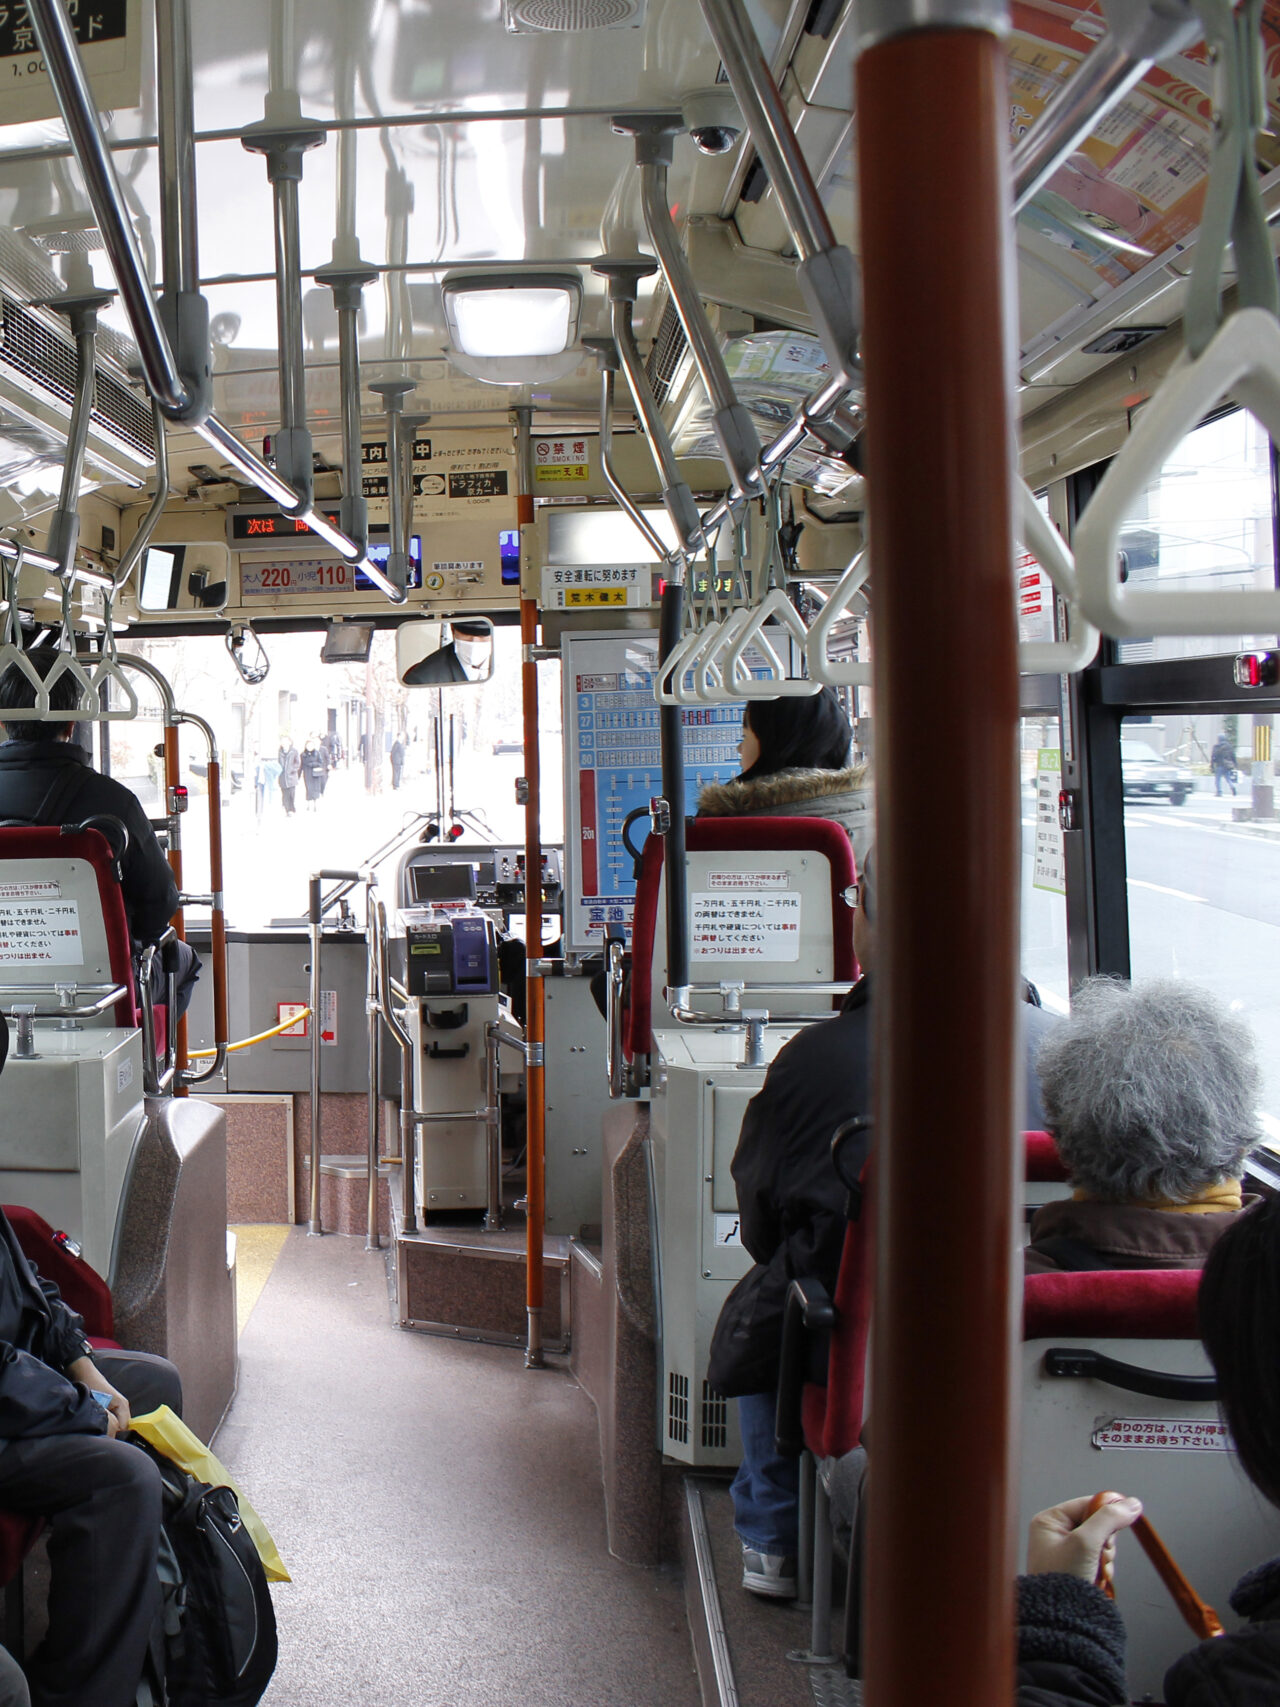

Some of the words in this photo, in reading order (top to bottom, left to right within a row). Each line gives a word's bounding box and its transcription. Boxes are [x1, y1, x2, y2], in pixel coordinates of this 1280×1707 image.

[12, 60, 48, 77] 1,00
[553, 442, 585, 455] 禁煙
[552, 455, 585, 463] SMOKING
[451, 480, 491, 489] トラフィカ
[467, 487, 500, 496] 京カード
[247, 519, 275, 534] 次は
[554, 569, 637, 583] 安全運転に努めます
[581, 697, 590, 707] 3
[581, 716, 591, 727] 27
[581, 735, 591, 746] 32
[583, 831, 595, 840] 201
[1102, 1423, 1228, 1435] 降りの方は、バスが停ま
[1100, 1434, 1219, 1447] そのままお待ち下さい。
